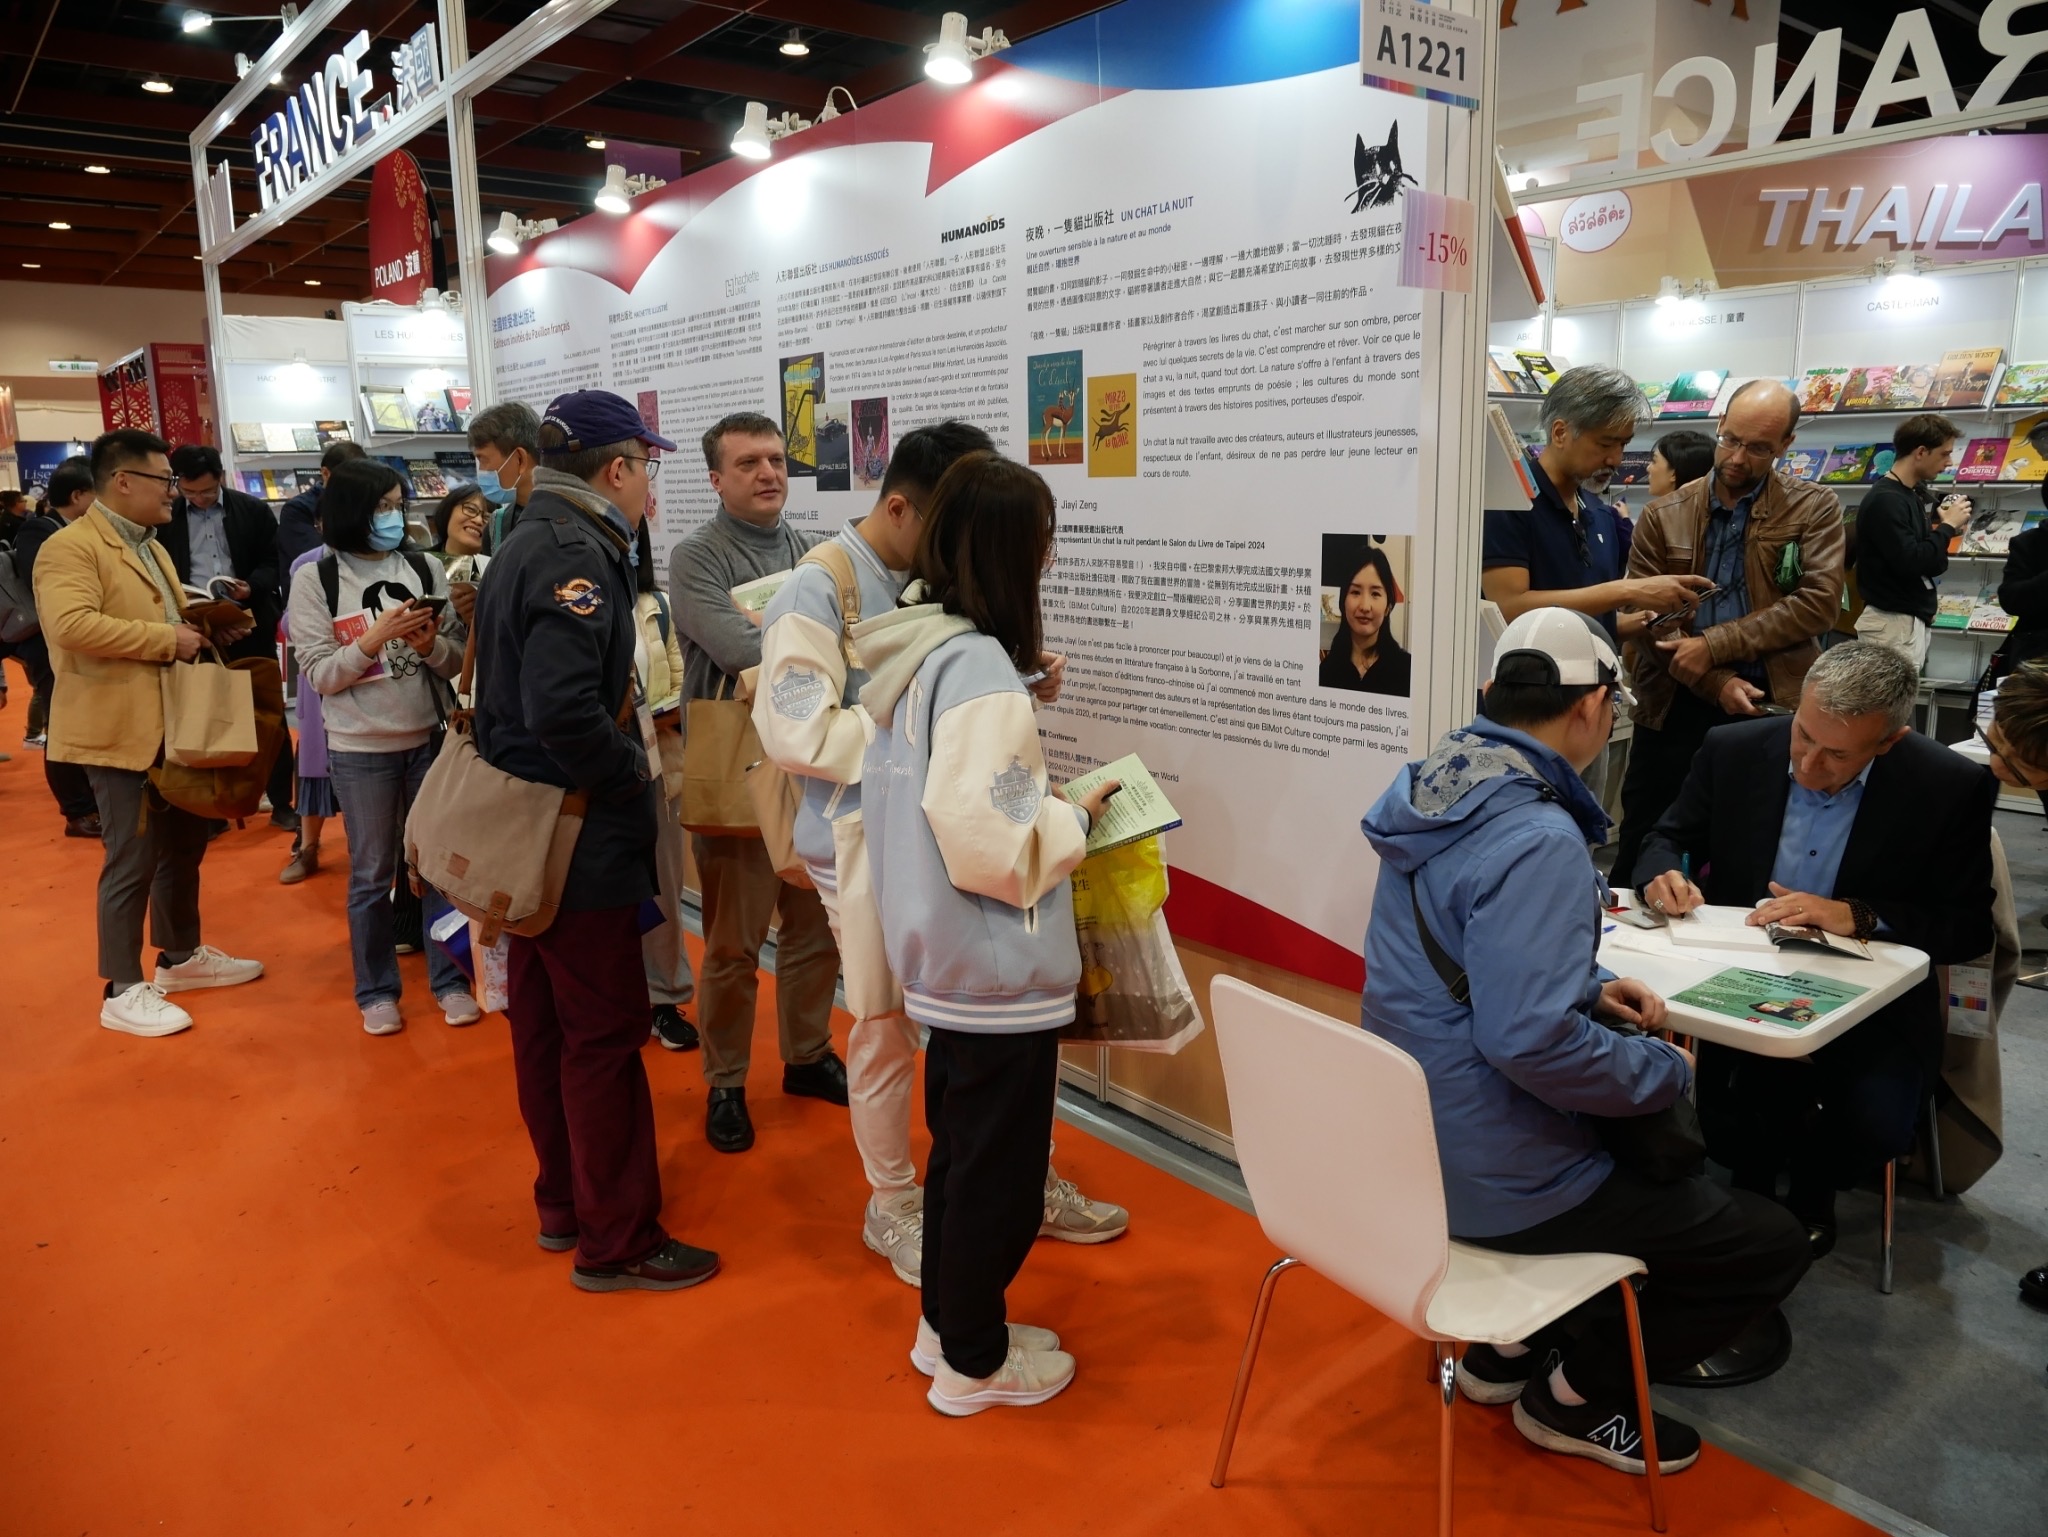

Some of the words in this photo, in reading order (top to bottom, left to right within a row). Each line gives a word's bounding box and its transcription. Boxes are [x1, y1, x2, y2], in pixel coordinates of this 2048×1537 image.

[1377, 25, 1465, 81] A1221
[250, 30, 377, 213] FRANCE
[391, 22, 442, 115] 法國
[1121, 209, 1133, 221] UN
[1135, 203, 1157, 218] CHAT
[1159, 201, 1170, 213] LA
[1172, 195, 1193, 211] NUIT
[1419, 230, 1468, 269] -15%
[374, 259, 403, 288] POLAND
[1726, 312, 1745, 324] 童書
[785, 510, 806, 520] Edmond
[807, 510, 819, 520] LEE
[1060, 499, 1077, 511] Jiayi
[1079, 499, 1097, 511] Zeng
[1275, 693, 1307, 704] aventure
[1309, 696, 1327, 707] dans
[1329, 699, 1336, 708] le
[1339, 702, 1365, 713] monde
[1368, 705, 1383, 715] des
[1385, 707, 1408, 719] livres.
[1292, 711, 1311, 721] étant
[1313, 714, 1344, 727] toujours
[1346, 720, 1358, 729] ma
[1360, 721, 1393, 736] passion,
[1395, 725, 1408, 737] j'ai
[1261, 722, 1282, 733] BiMot
[1283, 725, 1311, 738] Culture
[1312, 732, 1341, 743] compte
[1342, 737, 1364, 747] parmi
[1366, 739, 1378, 749] les
[1380, 743, 1408, 754] agents
[1274, 740, 1288, 751] livre
[1290, 743, 1300, 753] du
[1302, 747, 1329, 758] monde!
[1161, 770, 1179, 783] World
